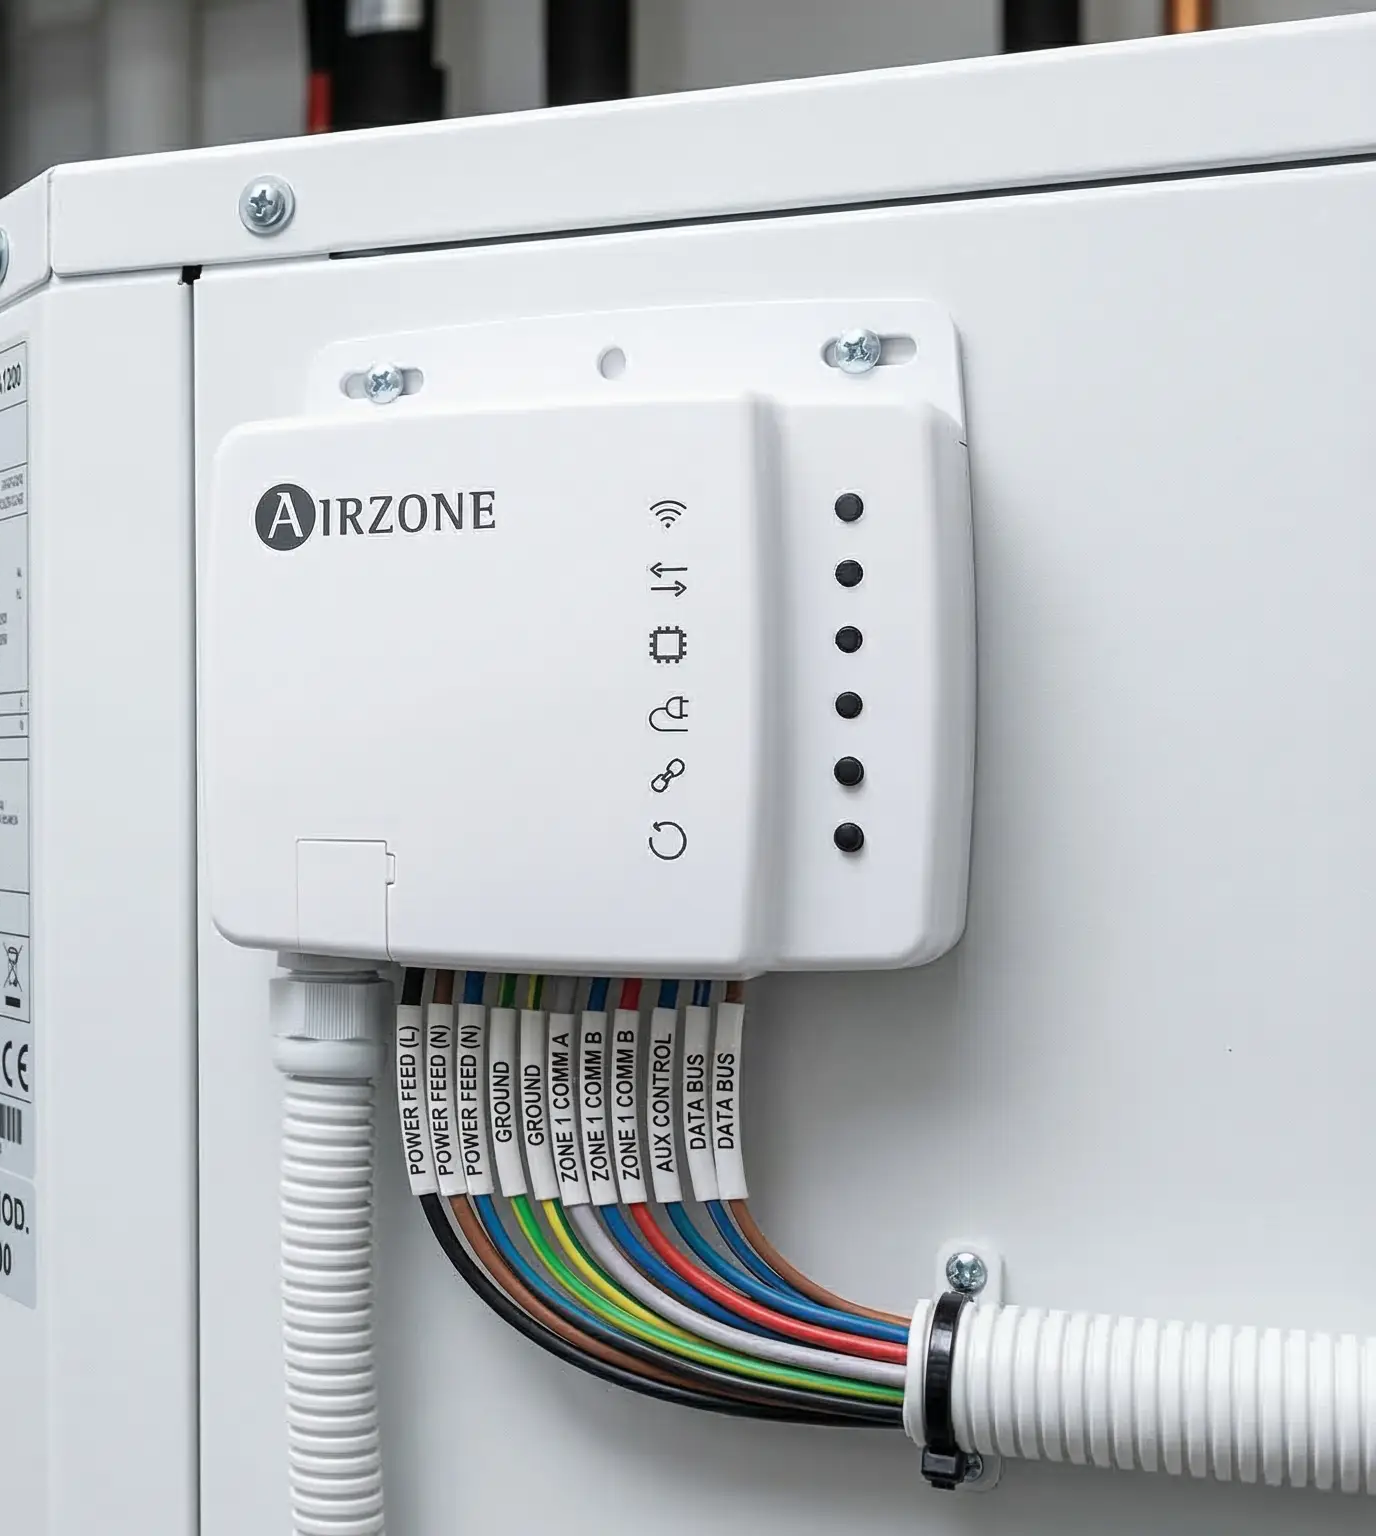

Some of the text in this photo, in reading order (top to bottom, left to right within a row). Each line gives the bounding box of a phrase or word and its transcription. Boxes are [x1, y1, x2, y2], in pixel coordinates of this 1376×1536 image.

[255, 483, 496, 551] AIRZONE
[399, 1025, 426, 1175] POWER FEED (L)
[430, 1024, 454, 1175] POWER FEED (N)
[460, 1024, 483, 1175] POWER FEED (N)
[493, 1061, 512, 1143] GROUND
[524, 1064, 545, 1146] GROUND
[552, 1032, 579, 1182] ZONE 1 COMM A
[584, 1031, 610, 1181] ZONE 1 COMM B
[616, 1030, 640, 1180] ZONE 1 COMM B
[652, 1033, 674, 1173] AUX CONTROL
[686, 1054, 706, 1150] DATA BUS
[716, 1053, 735, 1149] DATA BUS
